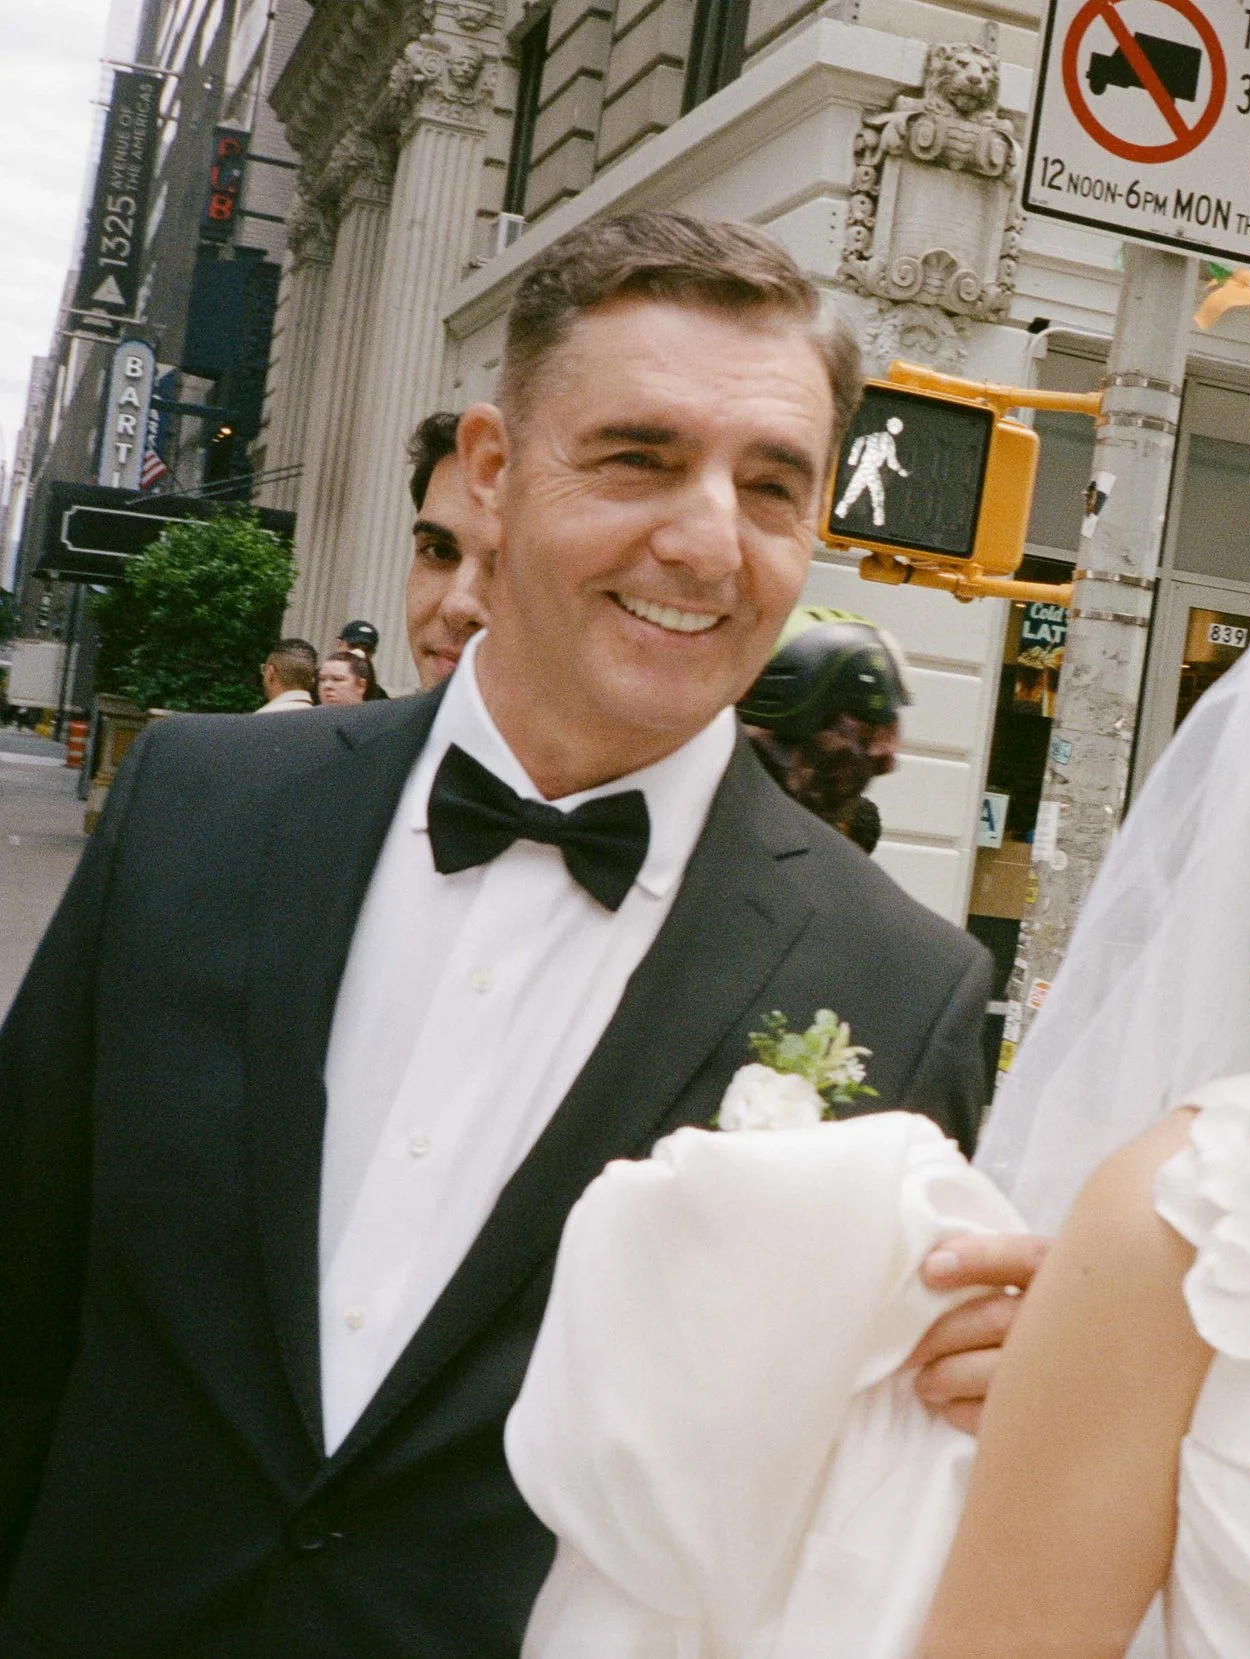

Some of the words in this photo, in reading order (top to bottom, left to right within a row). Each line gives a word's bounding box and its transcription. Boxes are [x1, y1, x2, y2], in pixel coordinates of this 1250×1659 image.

[126, 162, 142, 191] THE
[1172, 189, 1232, 231] MON
[99, 195, 137, 268] 1325
[1030, 602, 1064, 622] Cold
[1210, 625, 1244, 645] 839
